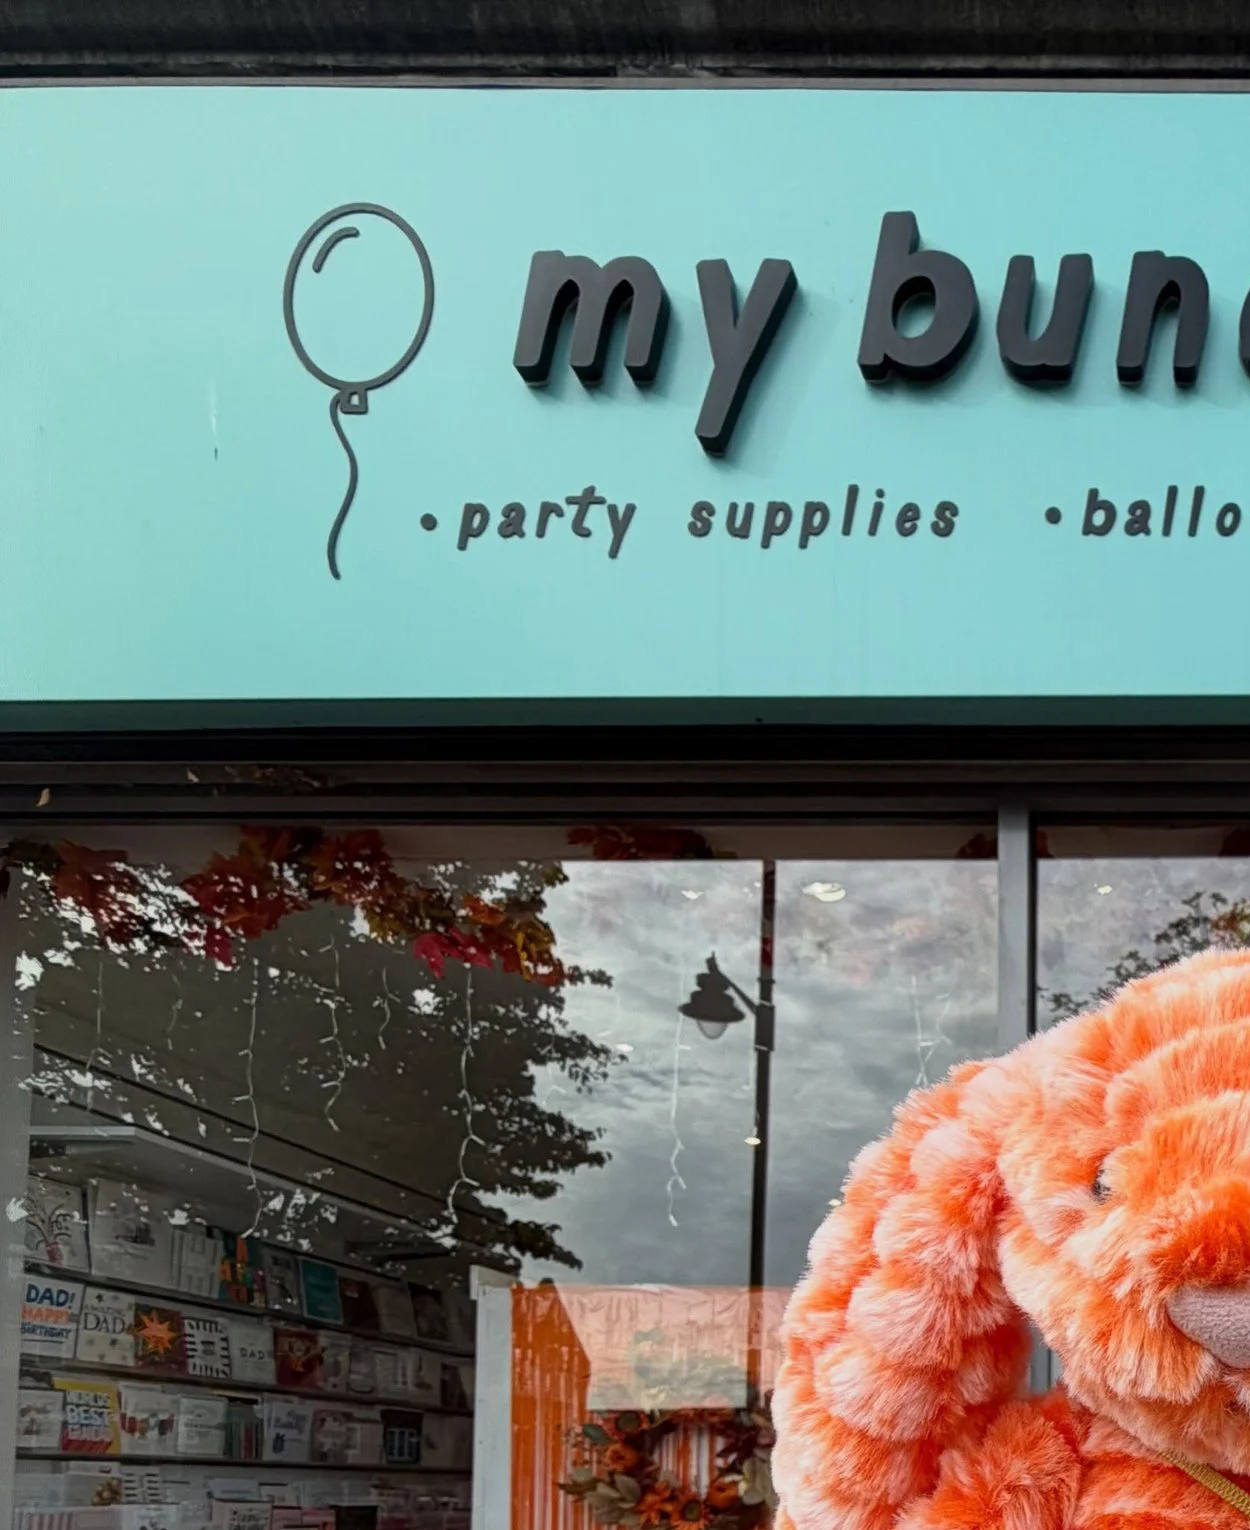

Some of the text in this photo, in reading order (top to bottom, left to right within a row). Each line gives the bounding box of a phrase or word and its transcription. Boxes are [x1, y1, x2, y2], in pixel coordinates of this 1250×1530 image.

[513, 250, 800, 456] my
[457, 484, 959, 559] party supplies
[26, 1283, 76, 1309] DAD!
[83, 1312, 125, 1335] DAD
[239, 1347, 265, 1361] DAD
